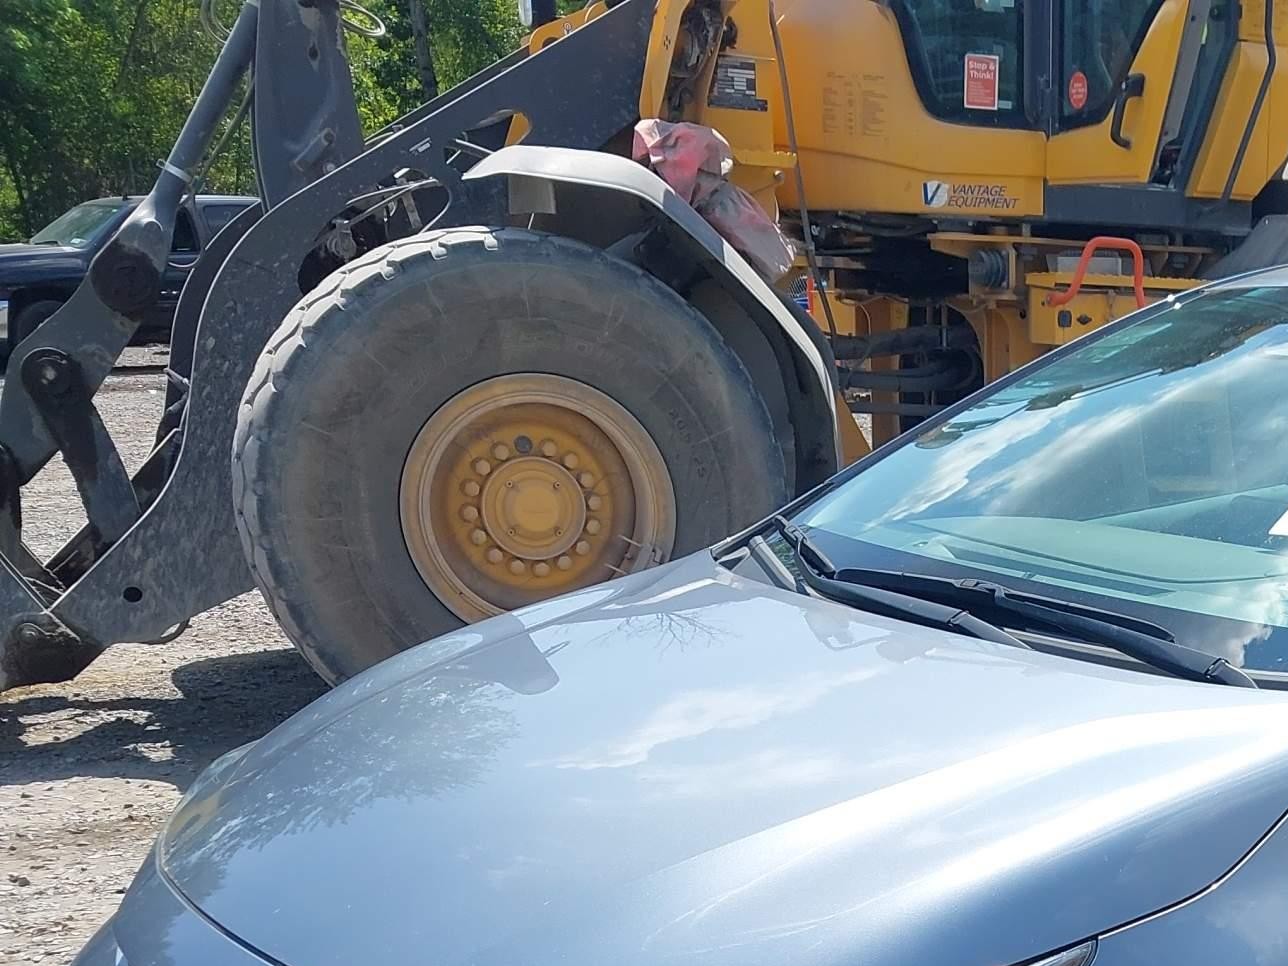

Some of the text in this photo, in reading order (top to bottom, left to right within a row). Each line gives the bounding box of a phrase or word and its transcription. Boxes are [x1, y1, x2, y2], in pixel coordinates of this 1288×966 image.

[969, 60, 995, 71] Stop &
[969, 71, 994, 80] Think!
[952, 184, 1007, 197] VANTAGE
[948, 195, 1020, 209] EQUIPMENT
